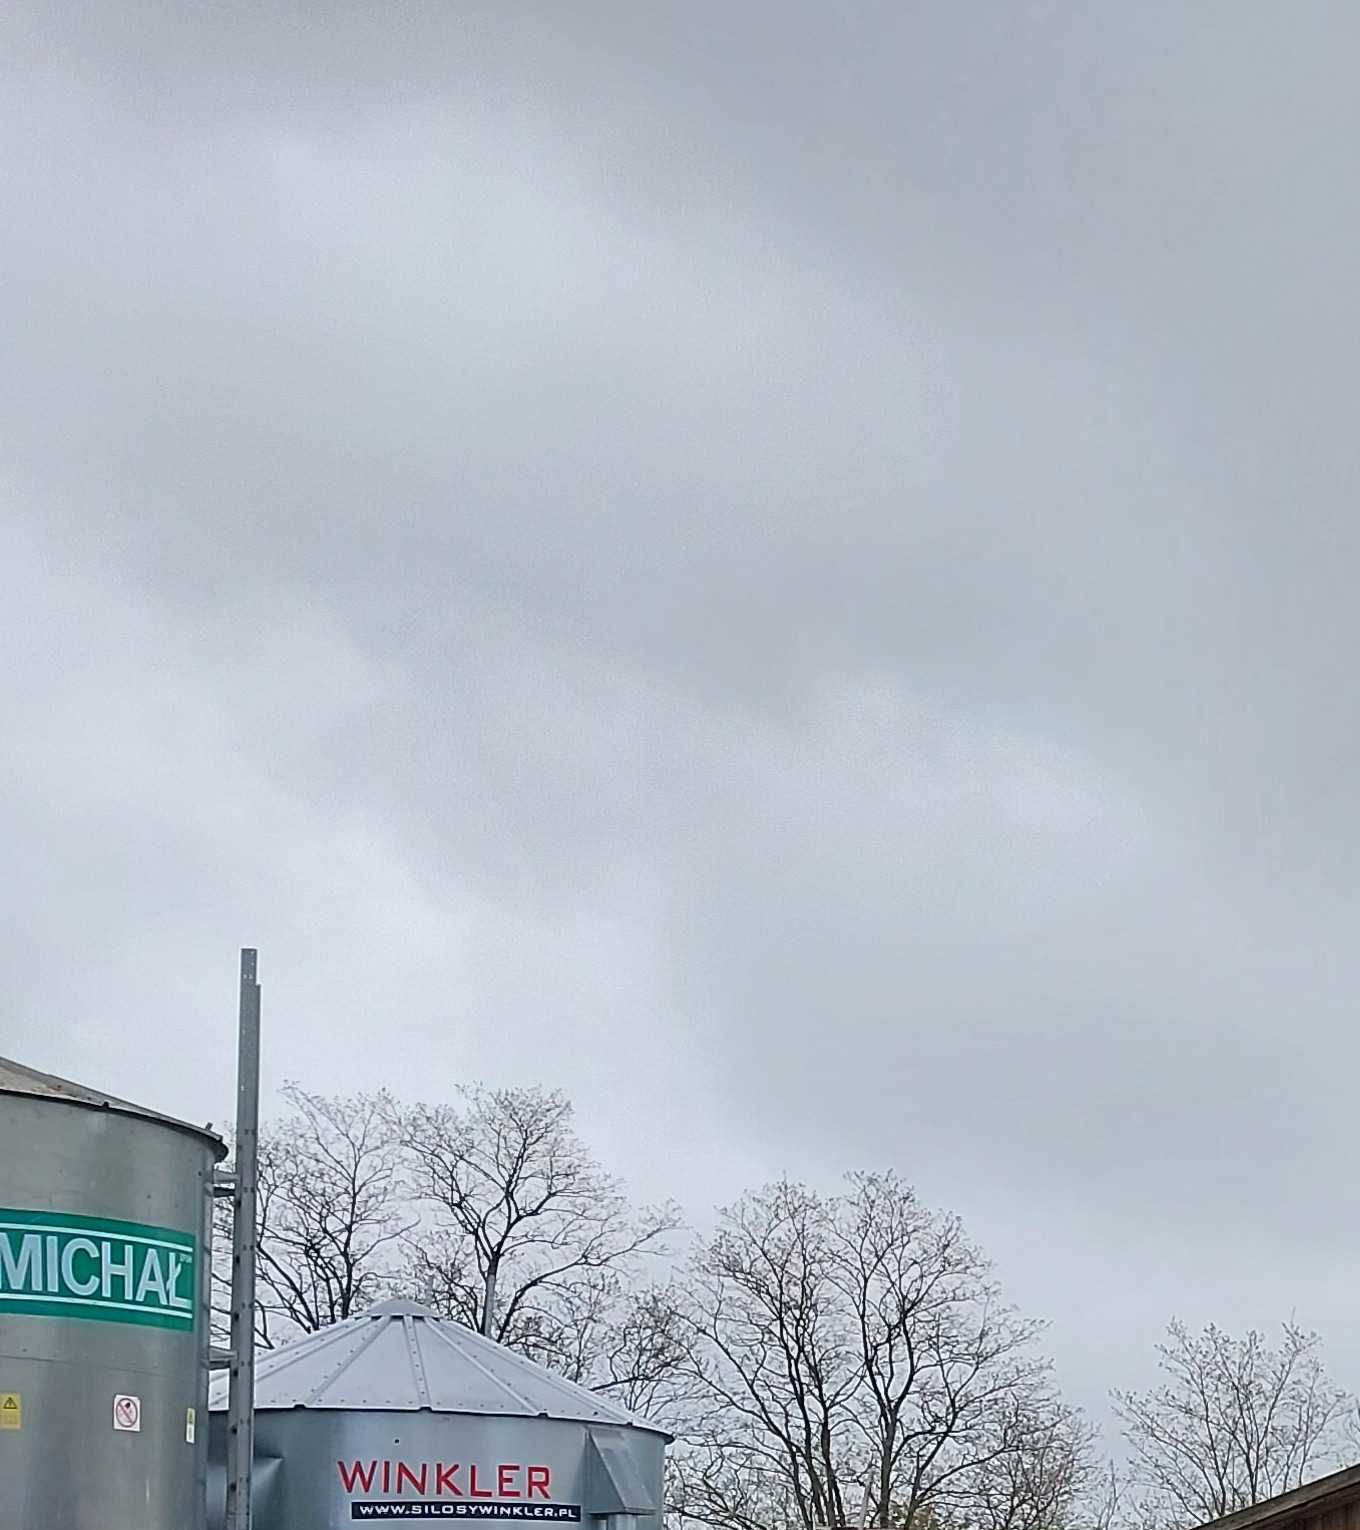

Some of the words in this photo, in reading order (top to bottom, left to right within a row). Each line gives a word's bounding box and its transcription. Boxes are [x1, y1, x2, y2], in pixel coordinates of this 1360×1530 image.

[0, 1232, 192, 1309] MICHAŁ
[337, 1460, 551, 1499] WINKLER
[359, 1504, 577, 1519] WWW.SILOSYWINKLER.PL
